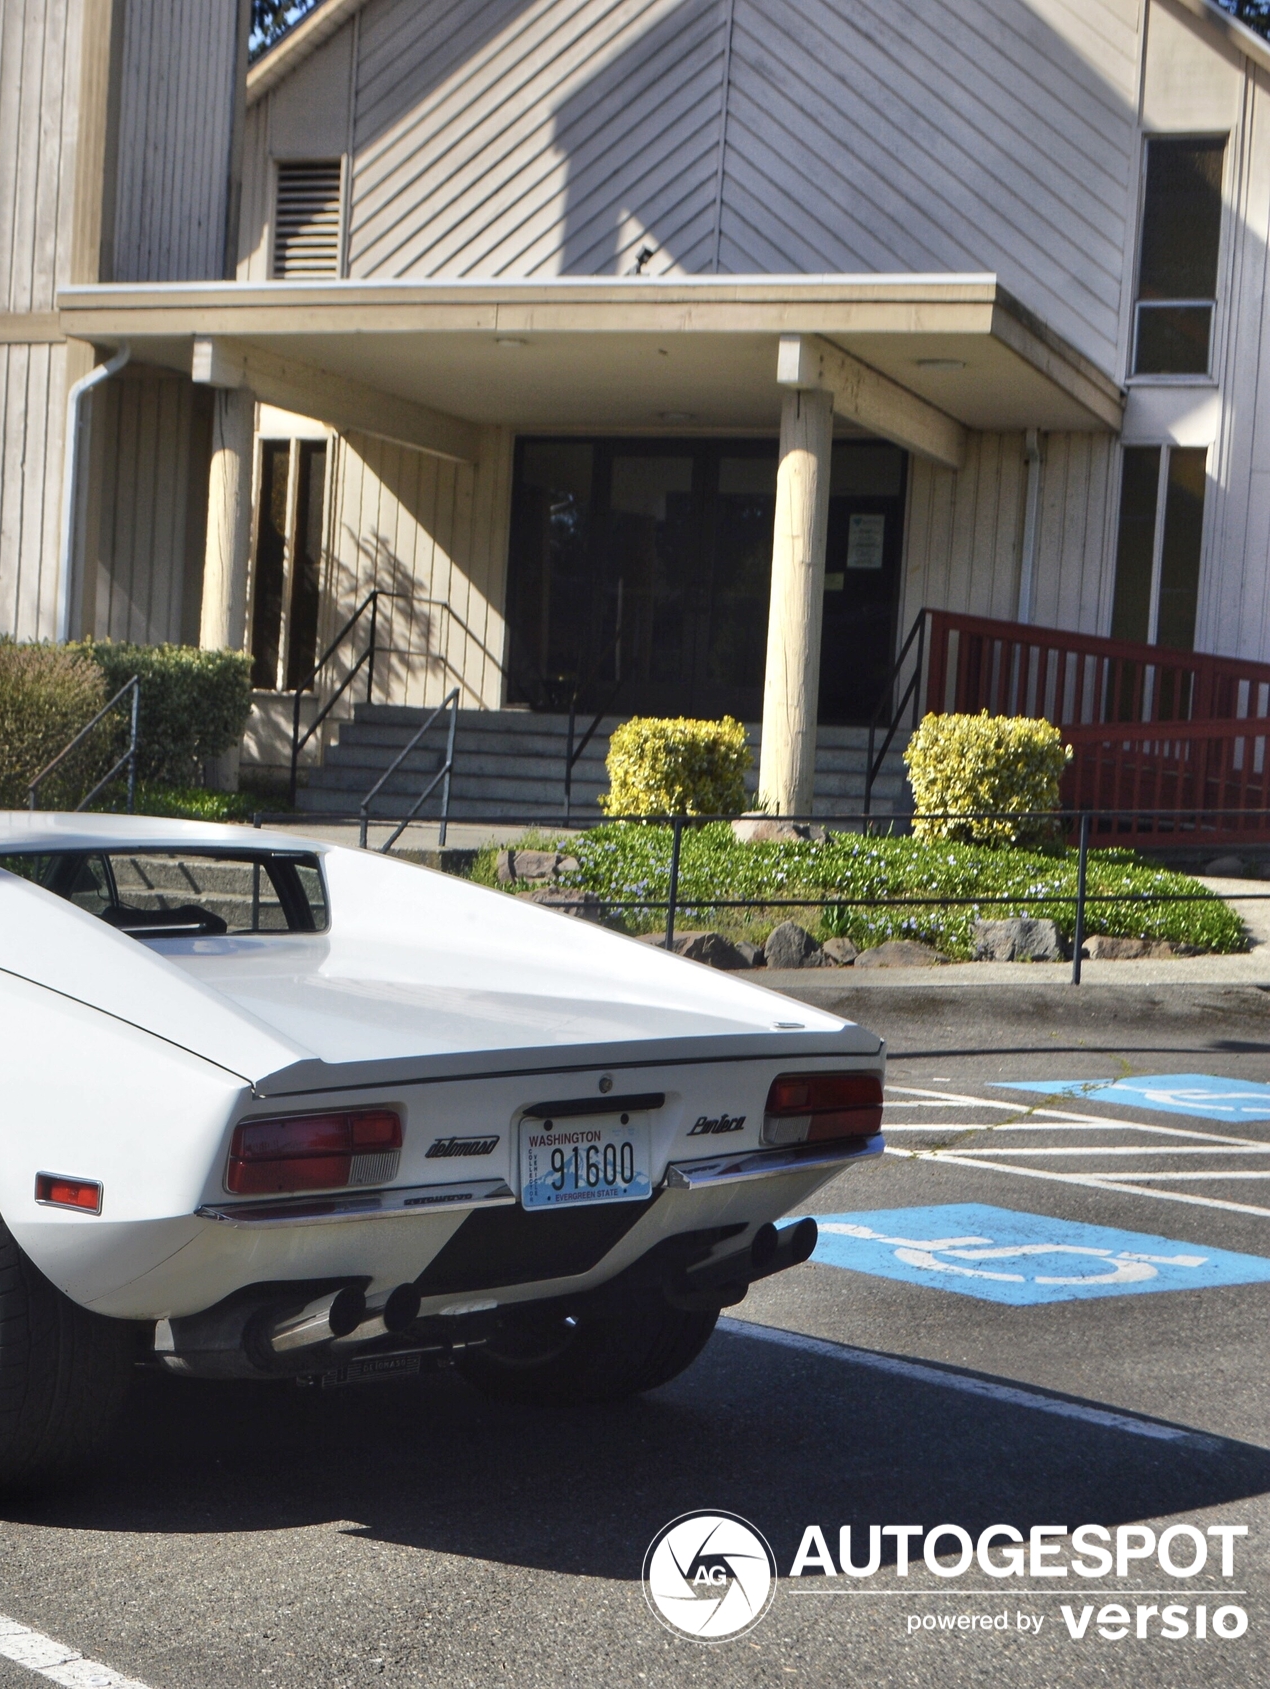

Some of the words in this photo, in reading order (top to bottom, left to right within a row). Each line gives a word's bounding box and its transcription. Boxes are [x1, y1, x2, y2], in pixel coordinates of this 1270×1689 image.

[686, 1114, 746, 1136] Pantera
[528, 1130, 602, 1148] WASHINGTON
[550, 1141, 635, 1192] 91600
[555, 1190, 597, 1202] EVERGREEN
[597, 1188, 619, 1198] STATE
